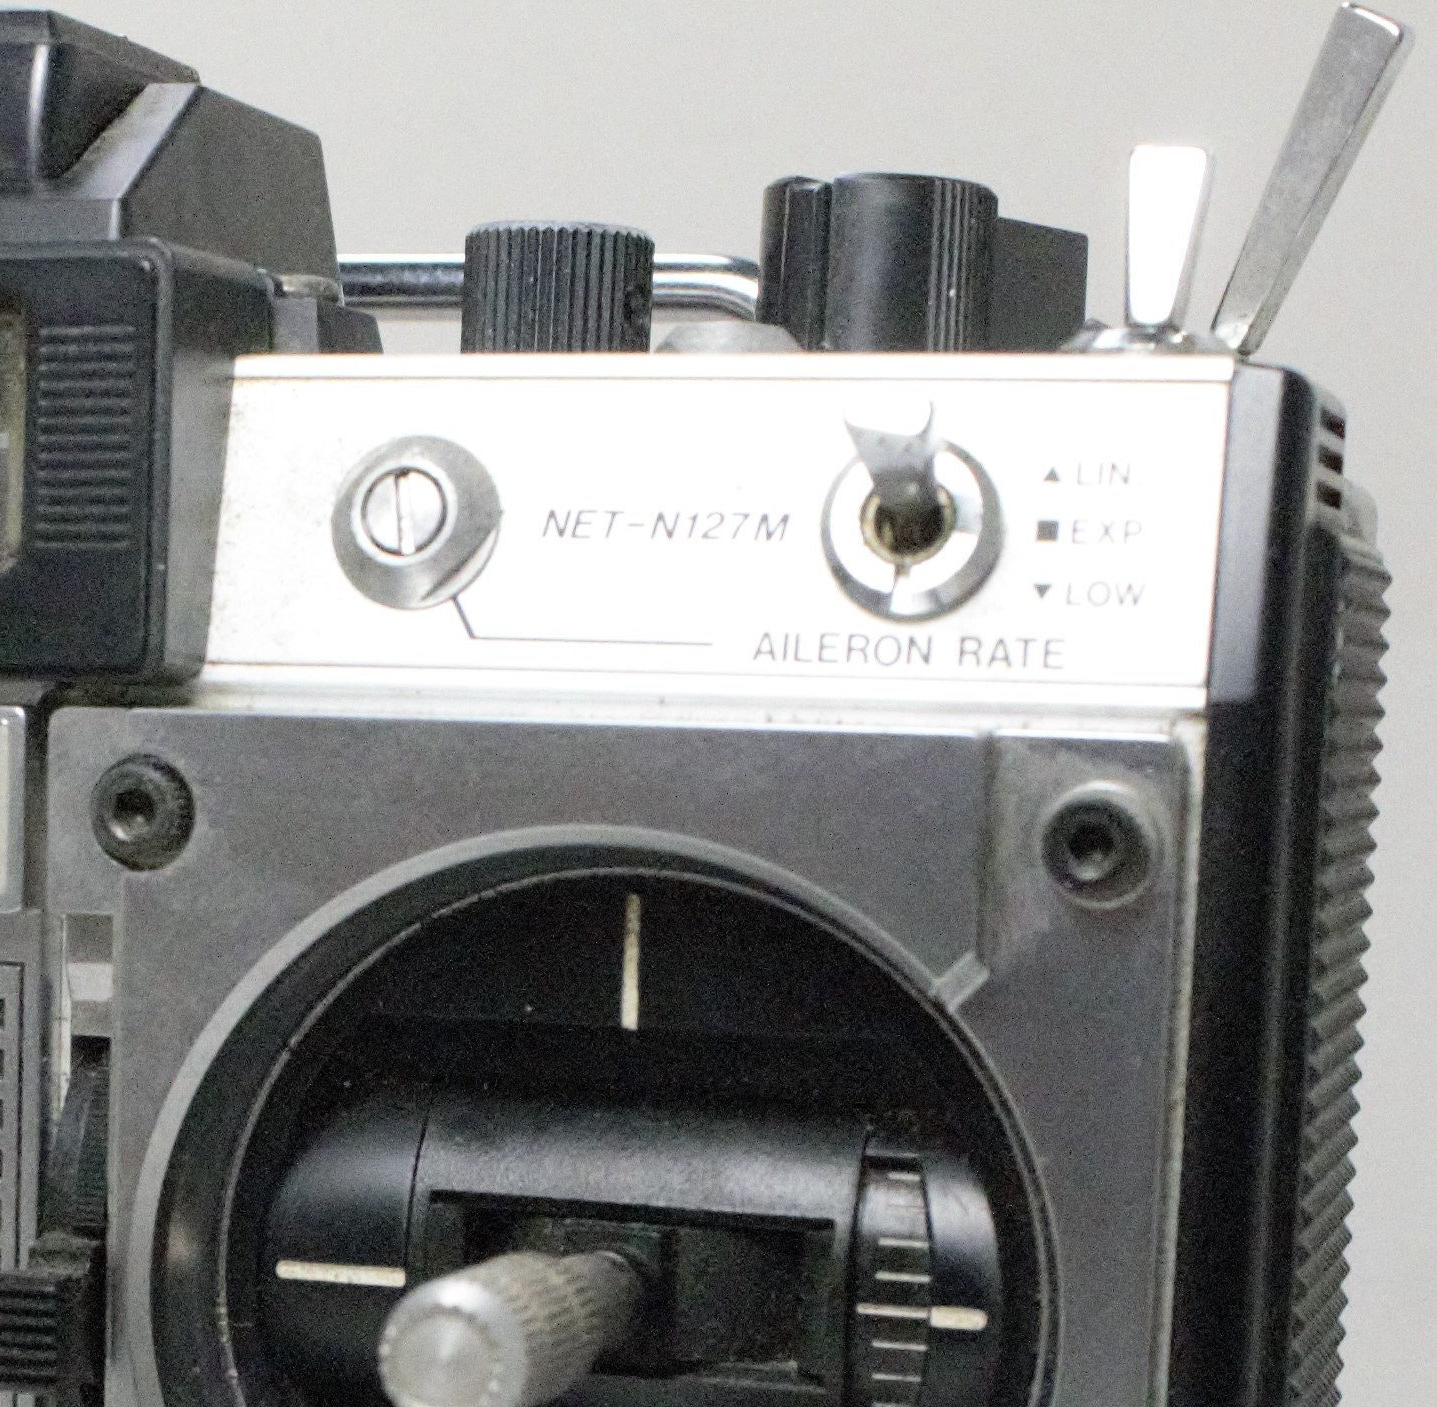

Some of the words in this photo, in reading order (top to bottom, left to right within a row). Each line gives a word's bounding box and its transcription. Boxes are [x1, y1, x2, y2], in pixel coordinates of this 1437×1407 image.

[1077, 462, 1132, 485] LIN
[543, 508, 790, 541] NET-N127M
[1072, 519, 1143, 544] EXP
[1066, 580, 1146, 606] LOW
[754, 633, 932, 666] AILERON
[957, 638, 1065, 669] RATE
